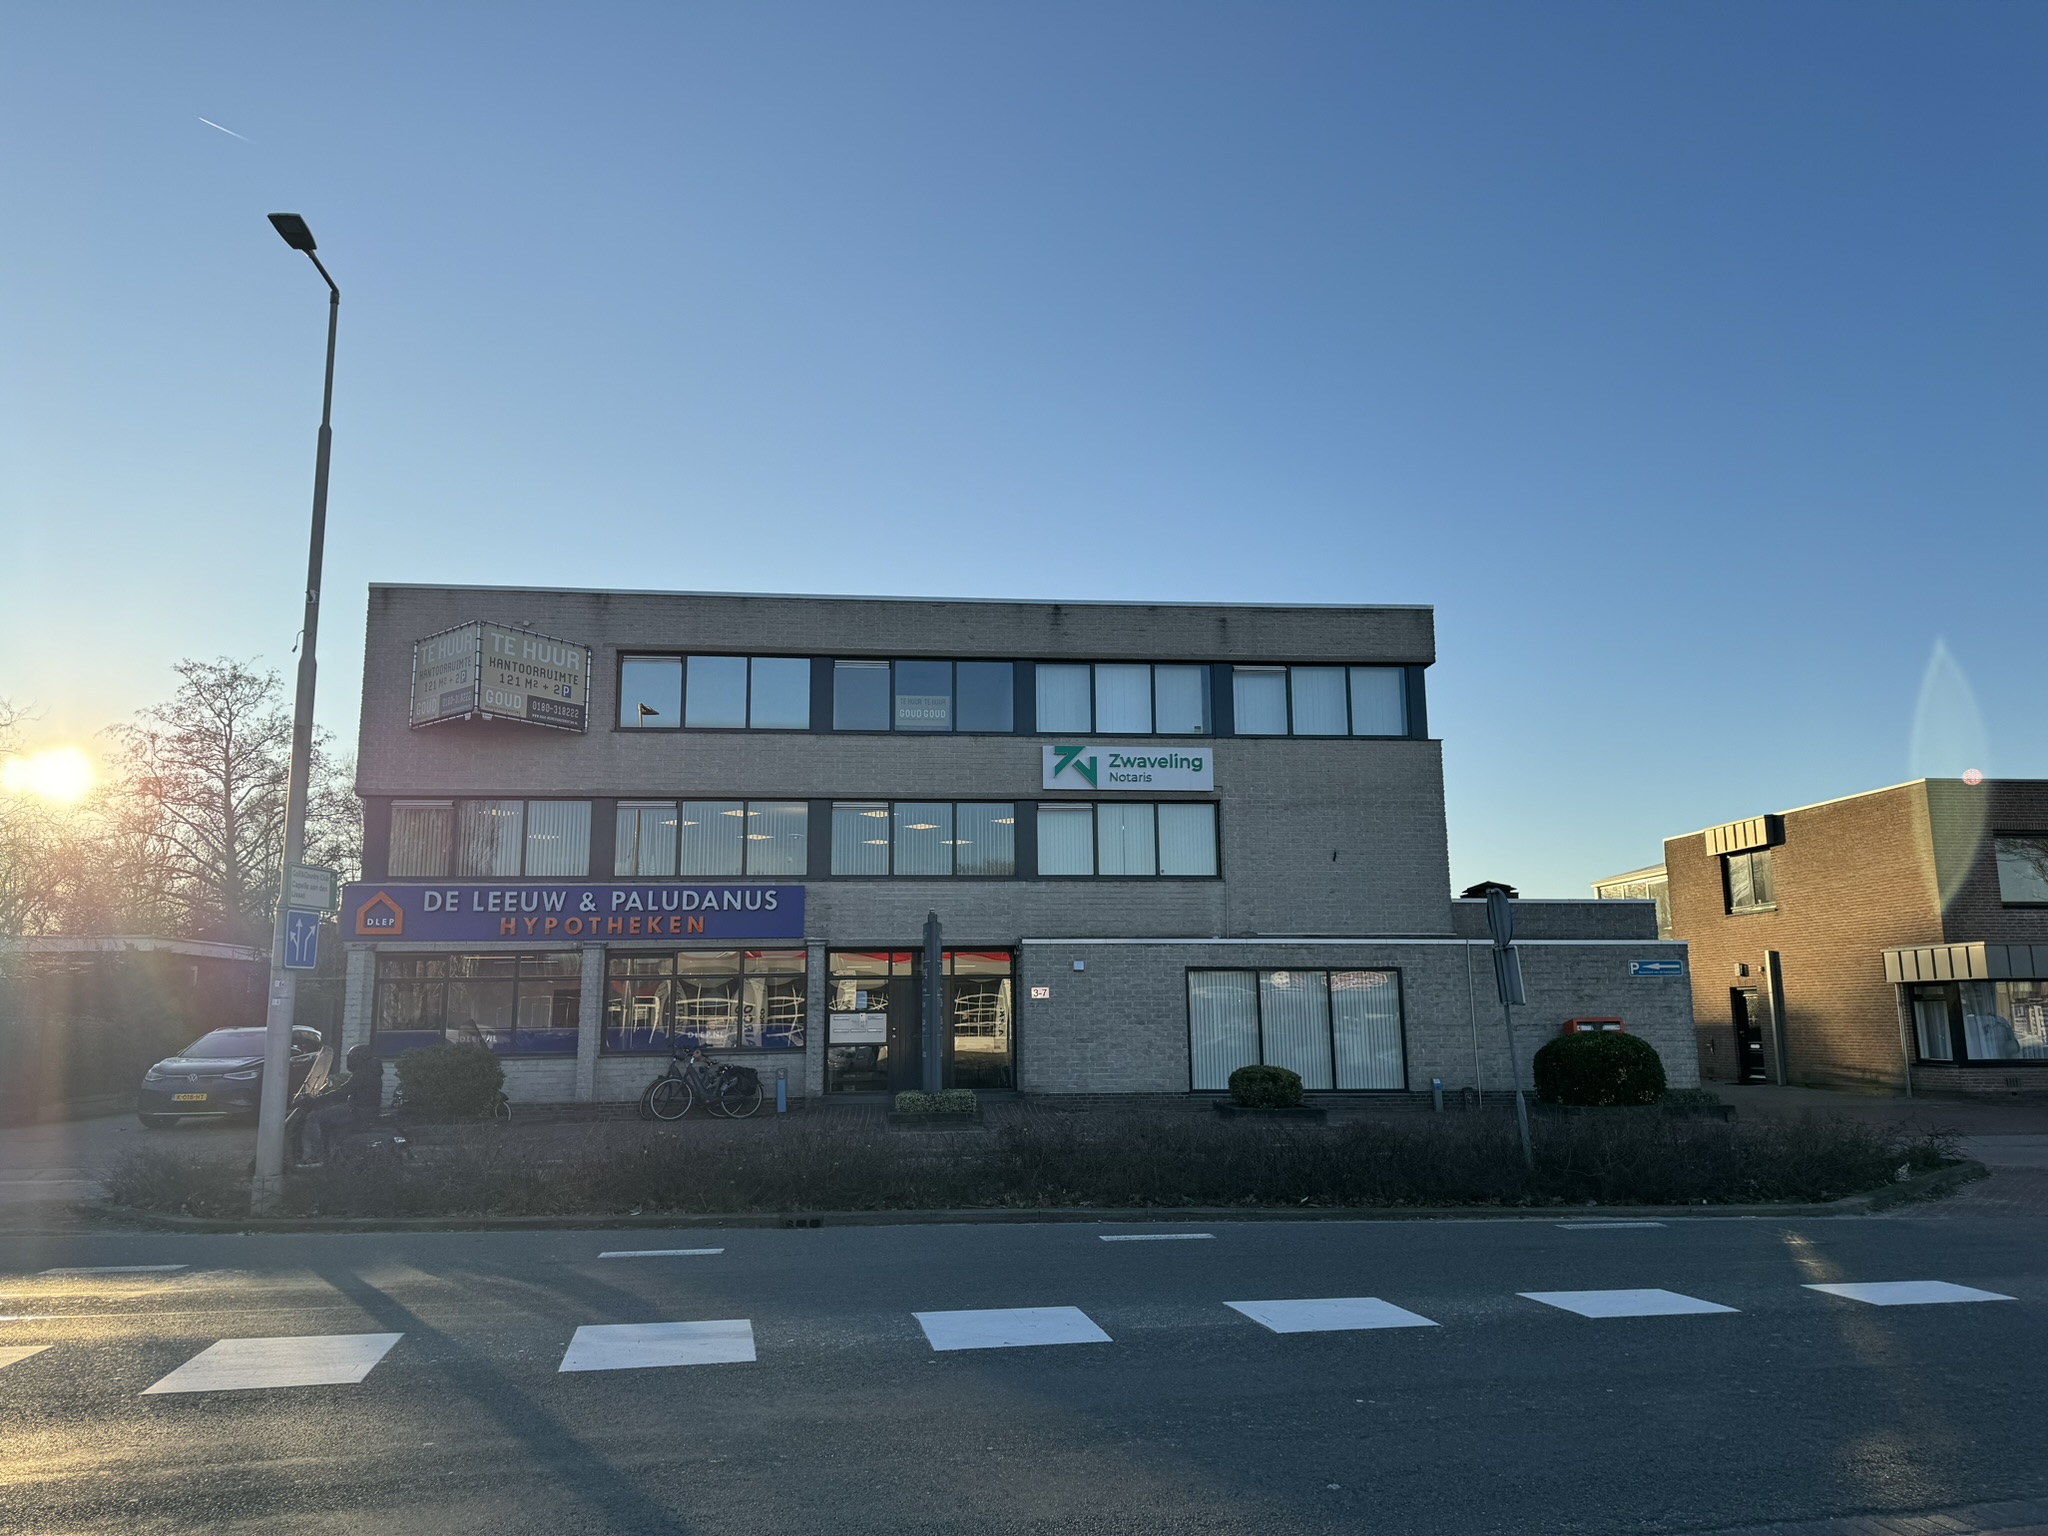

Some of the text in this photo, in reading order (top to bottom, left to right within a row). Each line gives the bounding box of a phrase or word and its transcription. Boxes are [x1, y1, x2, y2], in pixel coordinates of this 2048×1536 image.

[421, 632, 473, 665] TE HUUR
[491, 632, 580, 671] TE HUUR
[419, 656, 472, 679] KANTOORRUIMTE
[489, 656, 579, 686] KANTOORRUIMTE
[424, 679, 437, 693] 121
[500, 673, 521, 687] 121
[553, 684, 560, 695] 2
[416, 698, 437, 716] GOUD
[485, 689, 522, 709] GOUD
[532, 700, 579, 719] 0180-318222
[900, 709, 946, 718] GOUD GOUD
[1108, 753, 1203, 772] Zwaveling
[1109, 772, 1153, 783] Notaris
[423, 890, 778, 913] DE LEEUW & PALUDANUS
[366, 918, 395, 927] DLEP
[500, 916, 705, 936] HYPOTHEKEN
[1033, 988, 1048, 998] 3-7
